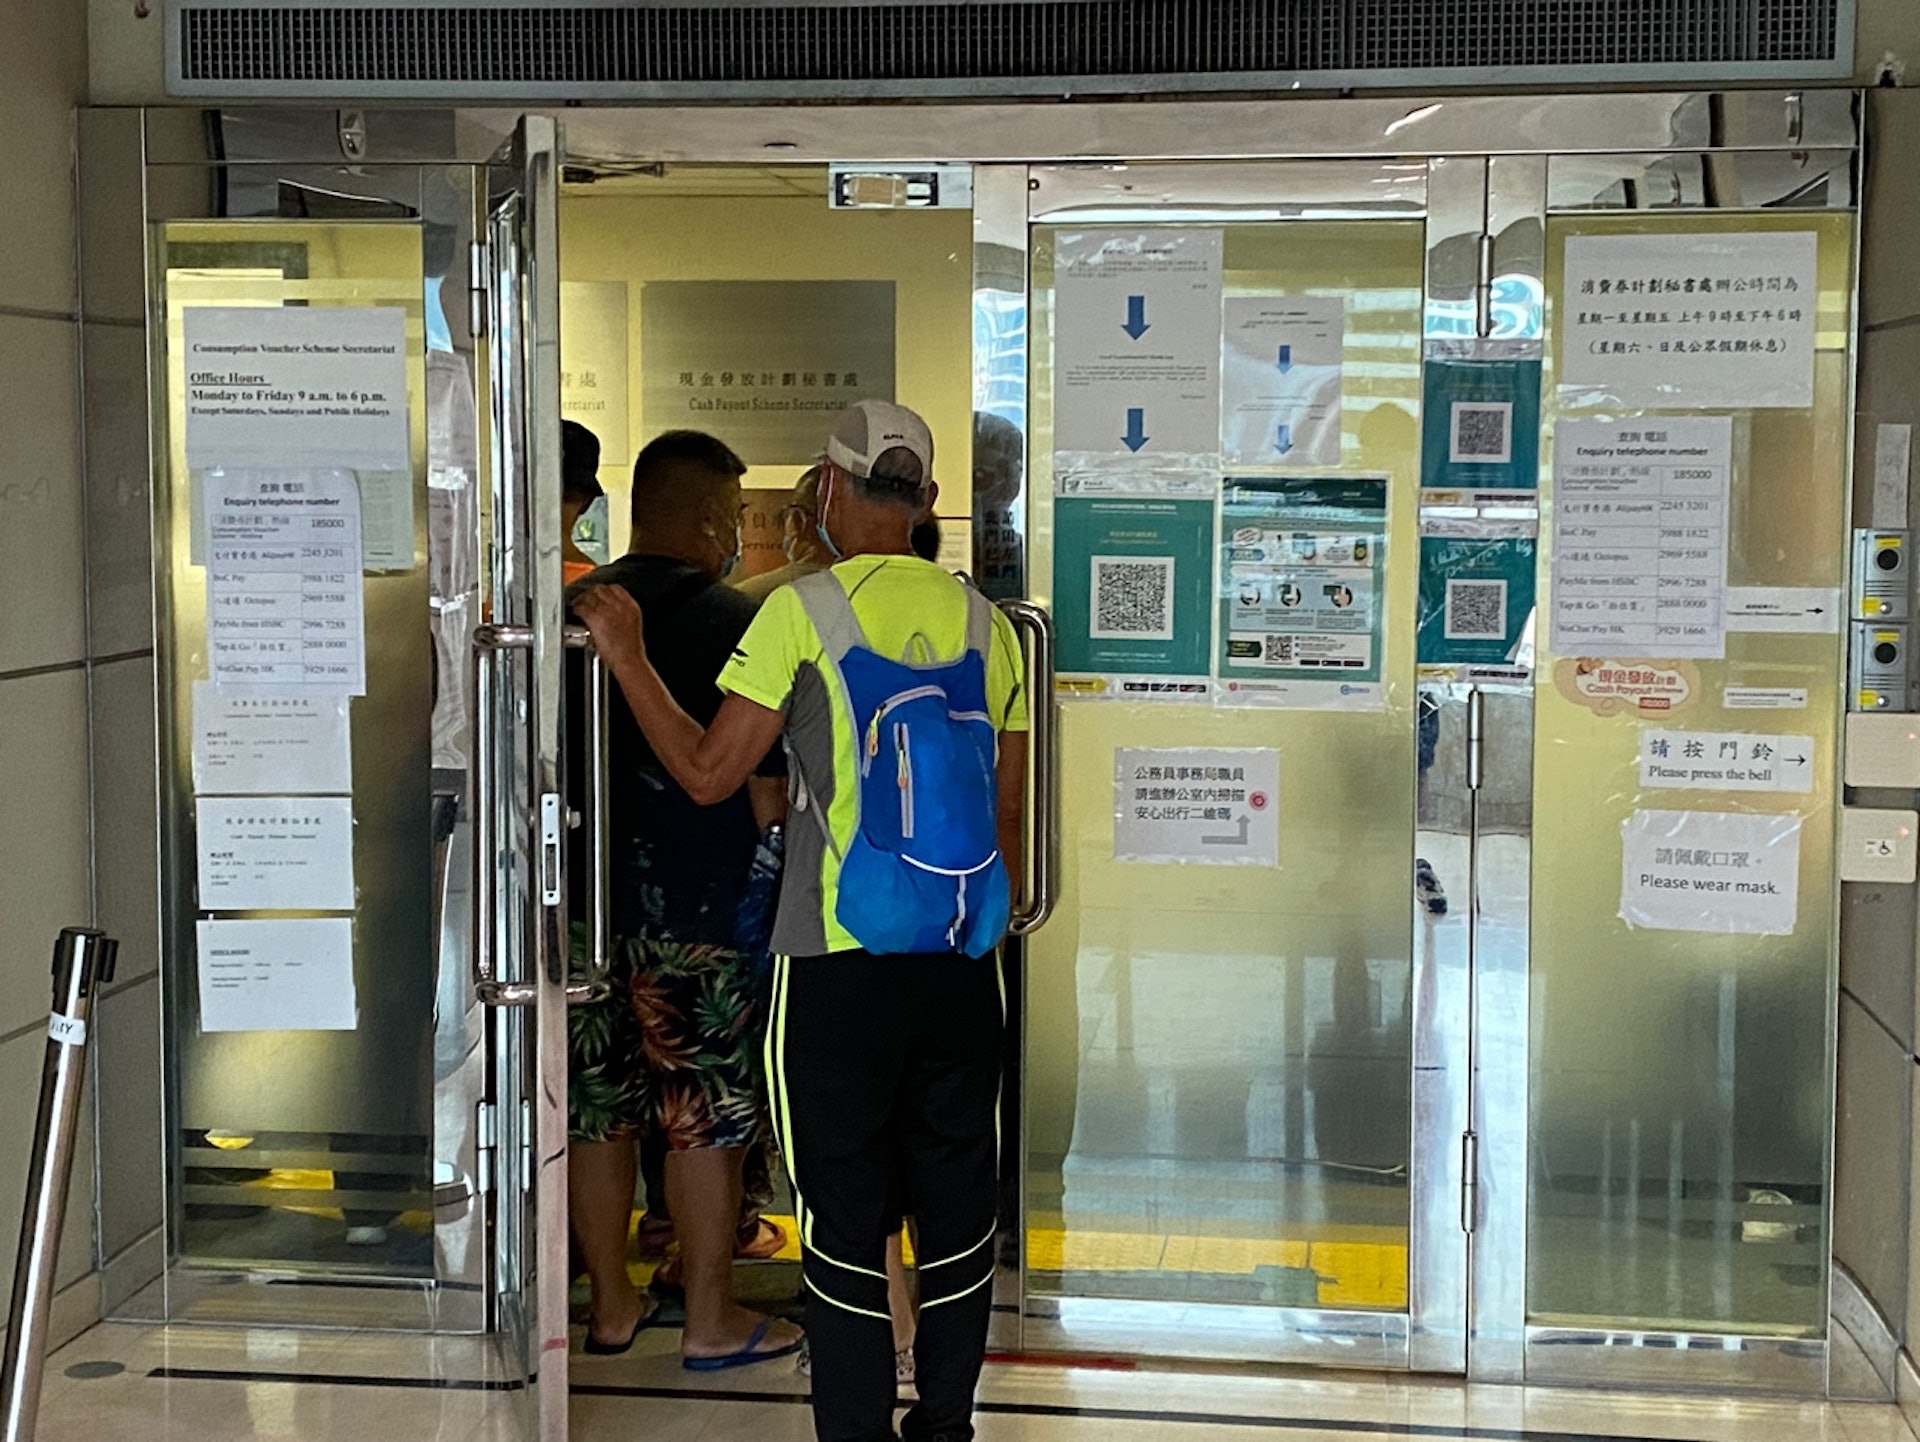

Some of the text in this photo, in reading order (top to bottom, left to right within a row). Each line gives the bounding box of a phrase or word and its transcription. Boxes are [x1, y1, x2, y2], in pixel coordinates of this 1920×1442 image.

[190, 372, 264, 383] Office Hours
[678, 371, 858, 388] 現金發放計劃秘書處
[191, 390, 386, 404] Monday to Friday 9 a.m. to 6 p.m.
[689, 398, 714, 411] Cash
[715, 398, 750, 414] Payout
[751, 398, 790, 412] Scheme
[1576, 447, 1708, 457] Enquiry telephone number
[1673, 469, 1712, 480] 185000
[224, 497, 340, 507] Enquiry telephone number
[1586, 683, 1614, 693] Cash
[1616, 685, 1652, 696] Payout
[1649, 739, 1774, 761] 請按門鈴
[1134, 766, 1245, 782] 公務員事務局職員
[1648, 766, 1772, 781] Please press the bell
[1134, 787, 1245, 802] 請進辦公室內掃描
[1134, 806, 1232, 821] 安心出行二維碼
[1640, 874, 1781, 895] Please wear mask.
